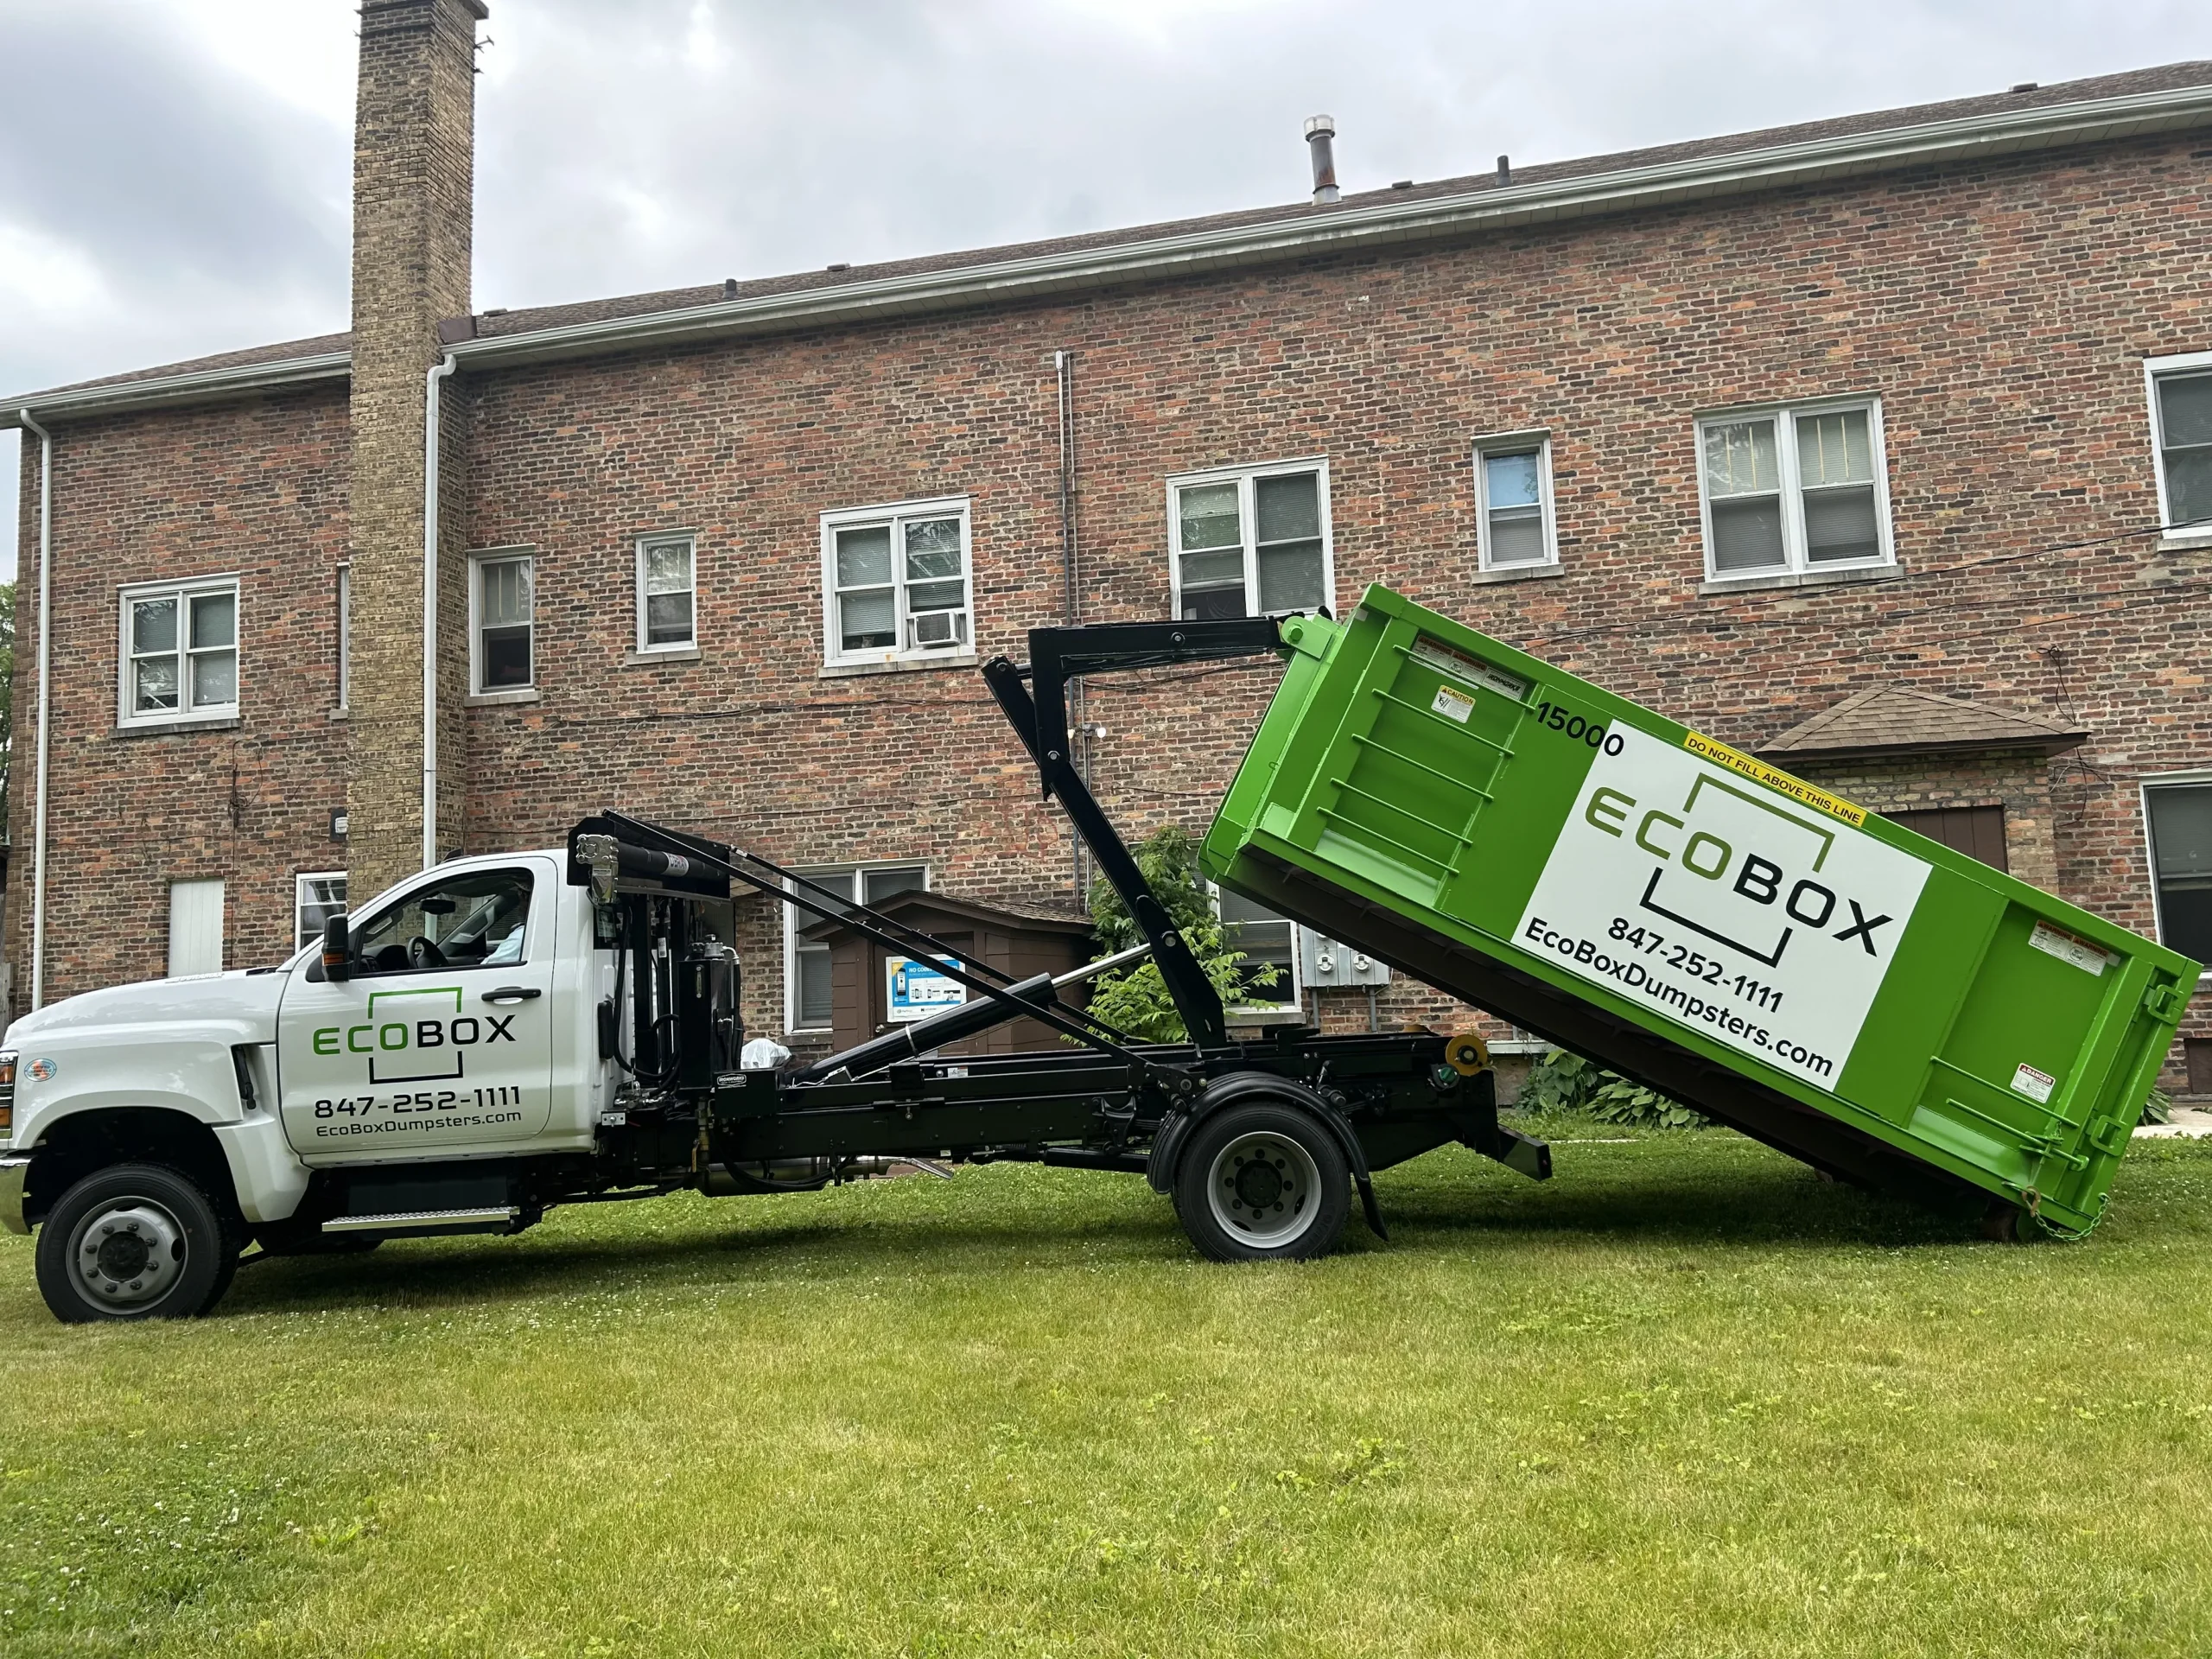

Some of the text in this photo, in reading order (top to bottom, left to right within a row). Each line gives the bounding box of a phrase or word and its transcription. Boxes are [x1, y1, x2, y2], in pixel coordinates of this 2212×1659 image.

[1424, 638, 1452, 655] WARNING
[1458, 654, 1486, 671] WARNING
[1446, 689, 1473, 704] CAUTION
[1537, 702, 1624, 757] 15000
[1688, 738, 1861, 823] DO NOT FILL ABOVE THIS LINE
[1584, 786, 1894, 957] ECOBOX
[2043, 923, 2071, 940] WARNING
[2078, 939, 2107, 957] WARNING
[1608, 917, 1784, 1014] 847-252-1111
[1524, 917, 1834, 1077] EcoBoxDumpsters.com
[313, 1014, 517, 1055] ECOBOX
[2026, 1068, 2052, 1084] DANGER
[315, 1085, 519, 1118] 847-252-1111
[316, 1111, 521, 1137] EcoBoxDumpsters.com
